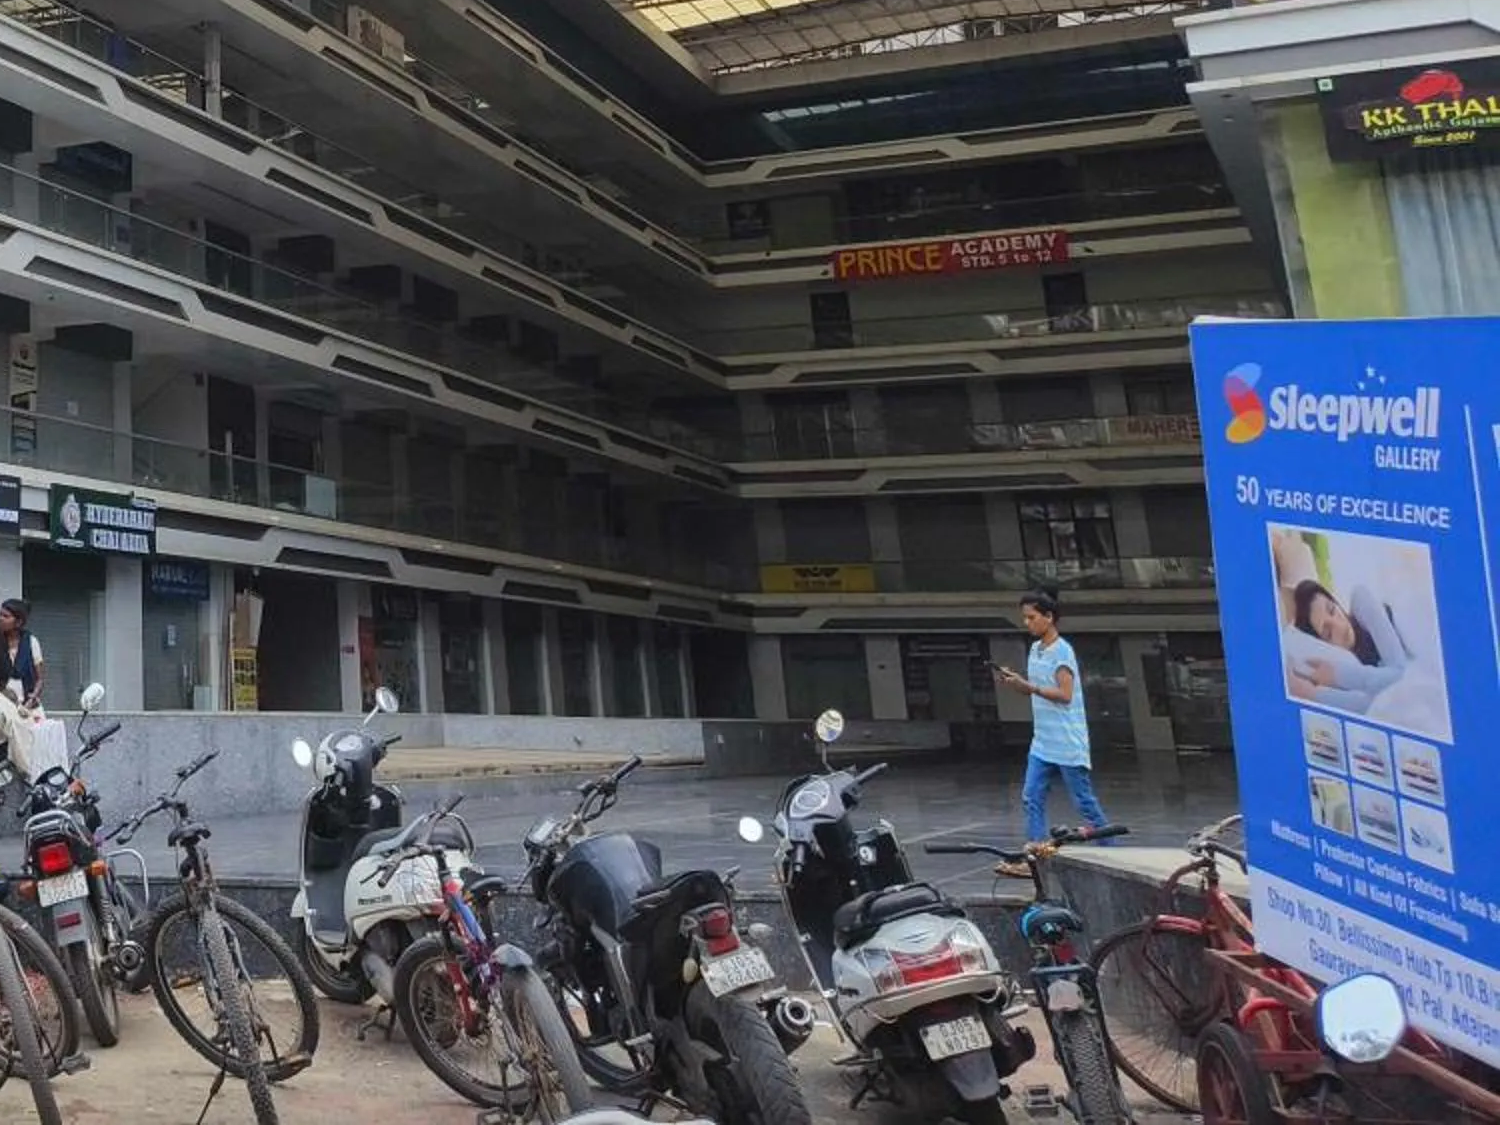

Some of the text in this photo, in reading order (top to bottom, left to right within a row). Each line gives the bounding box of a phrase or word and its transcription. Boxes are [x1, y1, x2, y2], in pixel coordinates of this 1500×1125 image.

[1361, 105, 1408, 129] KK
[838, 232, 1058, 278] PRINCE ACADEMY
[960, 252, 995, 269] STD.
[1035, 250, 1052, 263] 12
[1269, 384, 1440, 442] Sleepwell
[1375, 444, 1441, 472] GALLERY
[1235, 475, 1451, 529] 50 YEARS OF EXCELLENCE
[1267, 886, 1296, 923] Shop
[1338, 918, 1403, 967] Bellissimo
